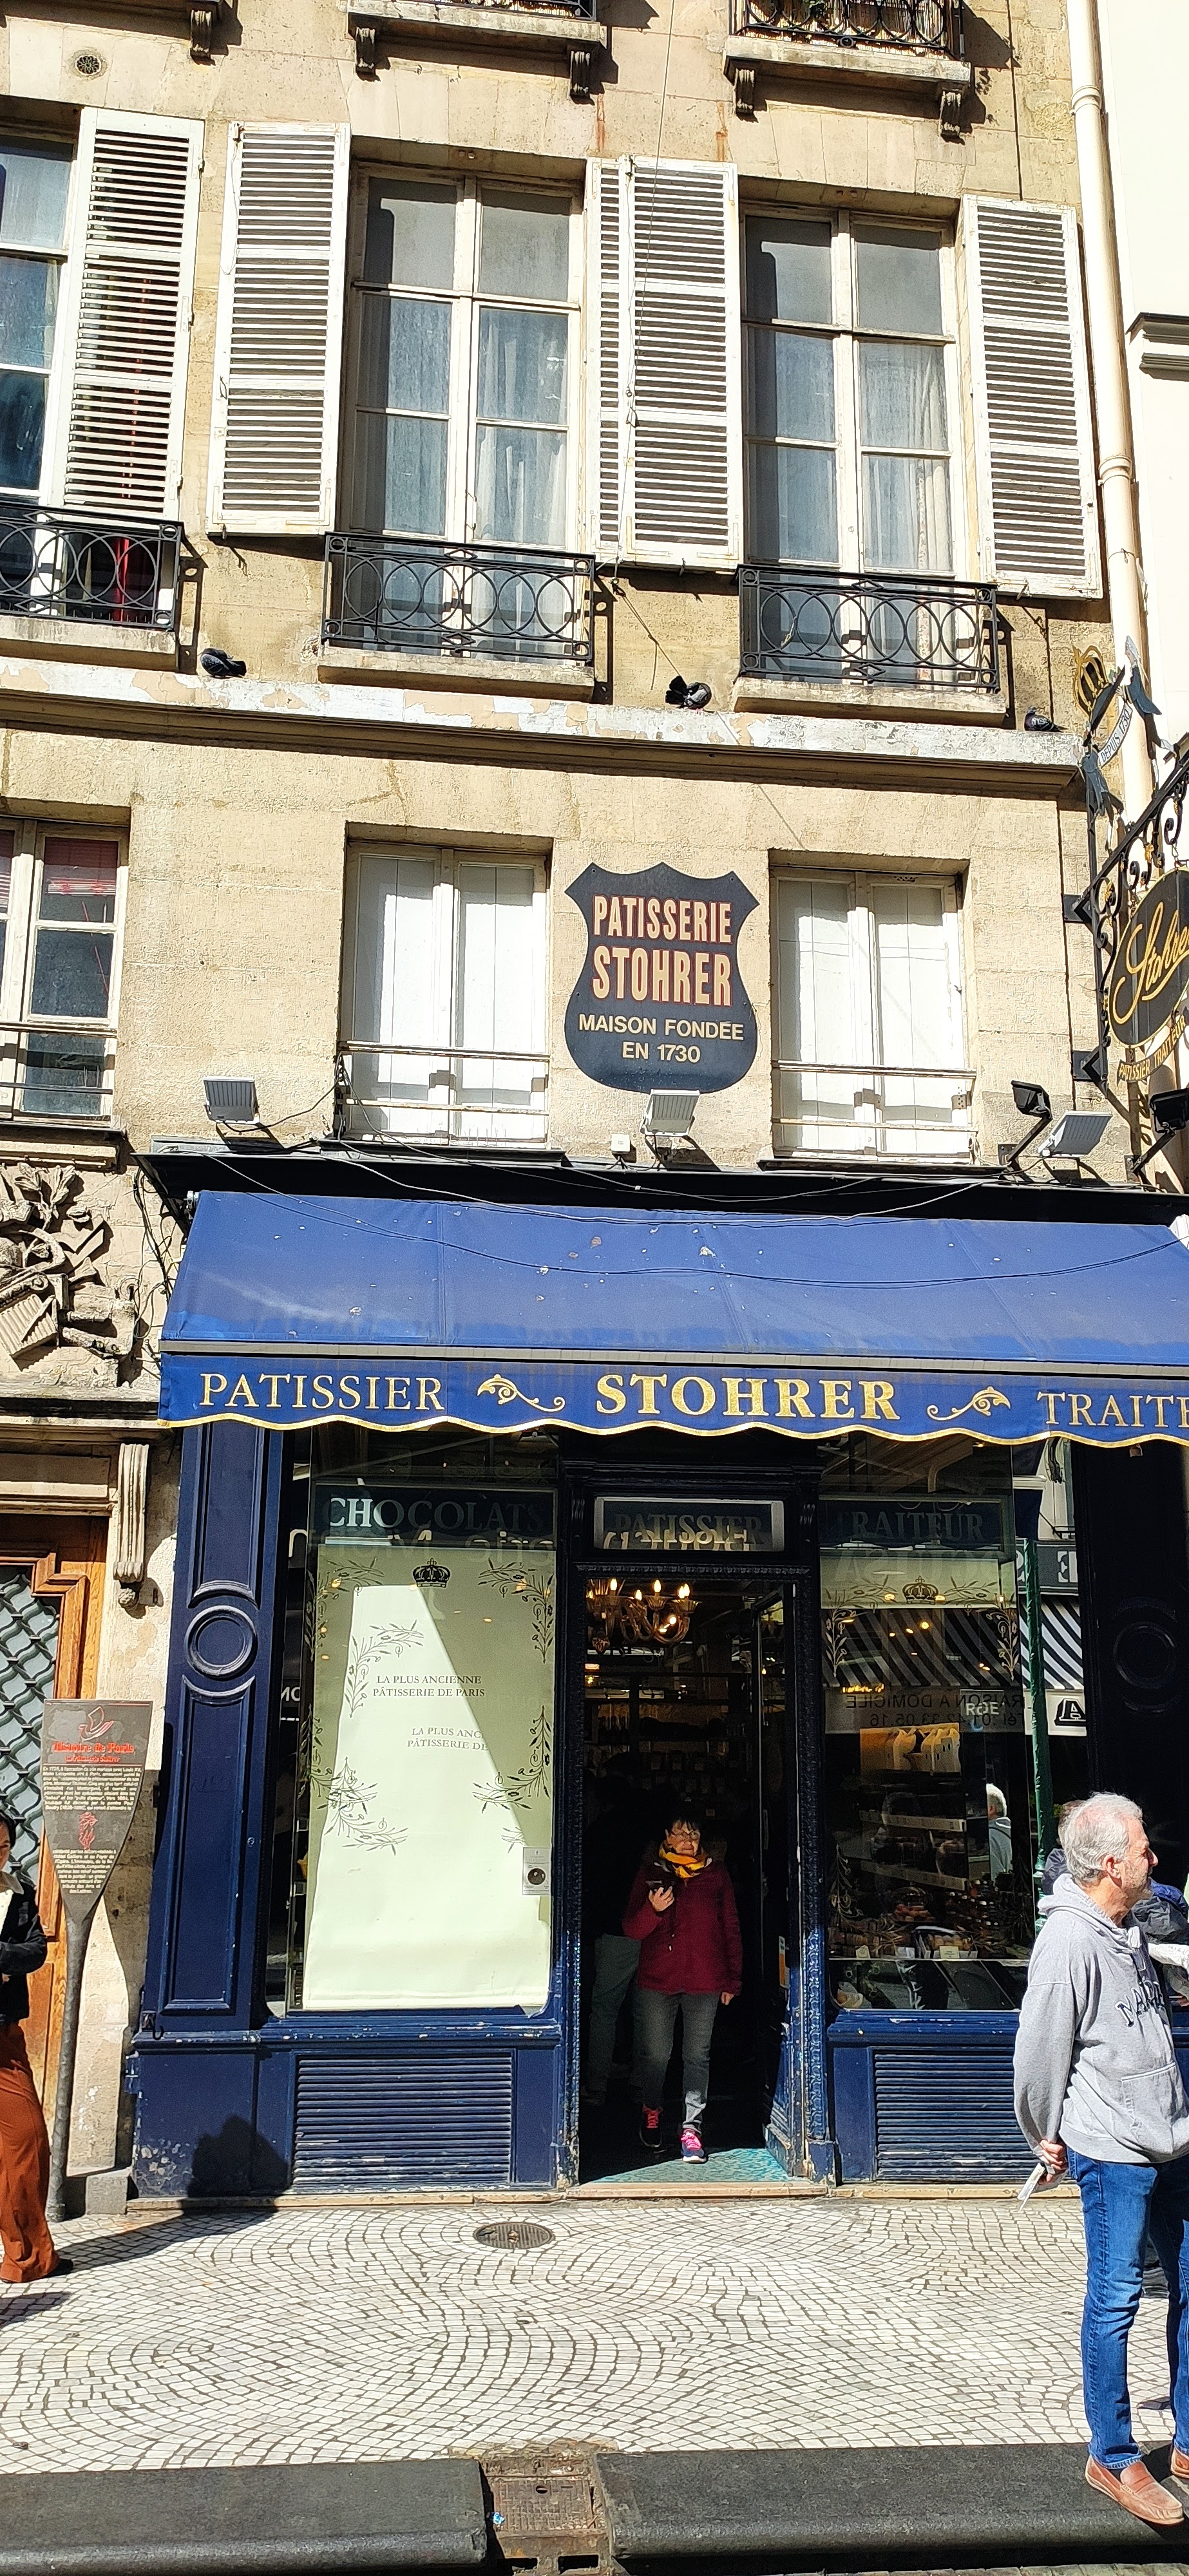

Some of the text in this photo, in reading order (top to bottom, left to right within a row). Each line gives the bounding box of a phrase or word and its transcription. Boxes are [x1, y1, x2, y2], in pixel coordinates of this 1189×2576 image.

[1100, 708, 1130, 763] DEPUIS 1730
[593, 894, 732, 944] PATISSERIE
[591, 945, 732, 1007] STOHRER
[1112, 901, 1189, 1025] Stohre
[579, 1014, 657, 1035] MAISON
[622, 1041, 701, 1063] EN 1730
[1119, 1014, 1186, 1081] PATISSIER TRAITEUR
[198, 1372, 446, 1411] PATISSIER
[596, 1373, 900, 1421] STOHRER
[614, 1513, 765, 1545] PATISSIER
[373, 1686, 435, 1697] PÂTISSERIE
[455, 1689, 485, 1697] PARIS
[393, 1676, 419, 1684] PLUS
[421, 1676, 482, 1684] ANCIENNE
[427, 1727, 454, 1736] PLUS
[457, 1729, 483, 1739] ANC
